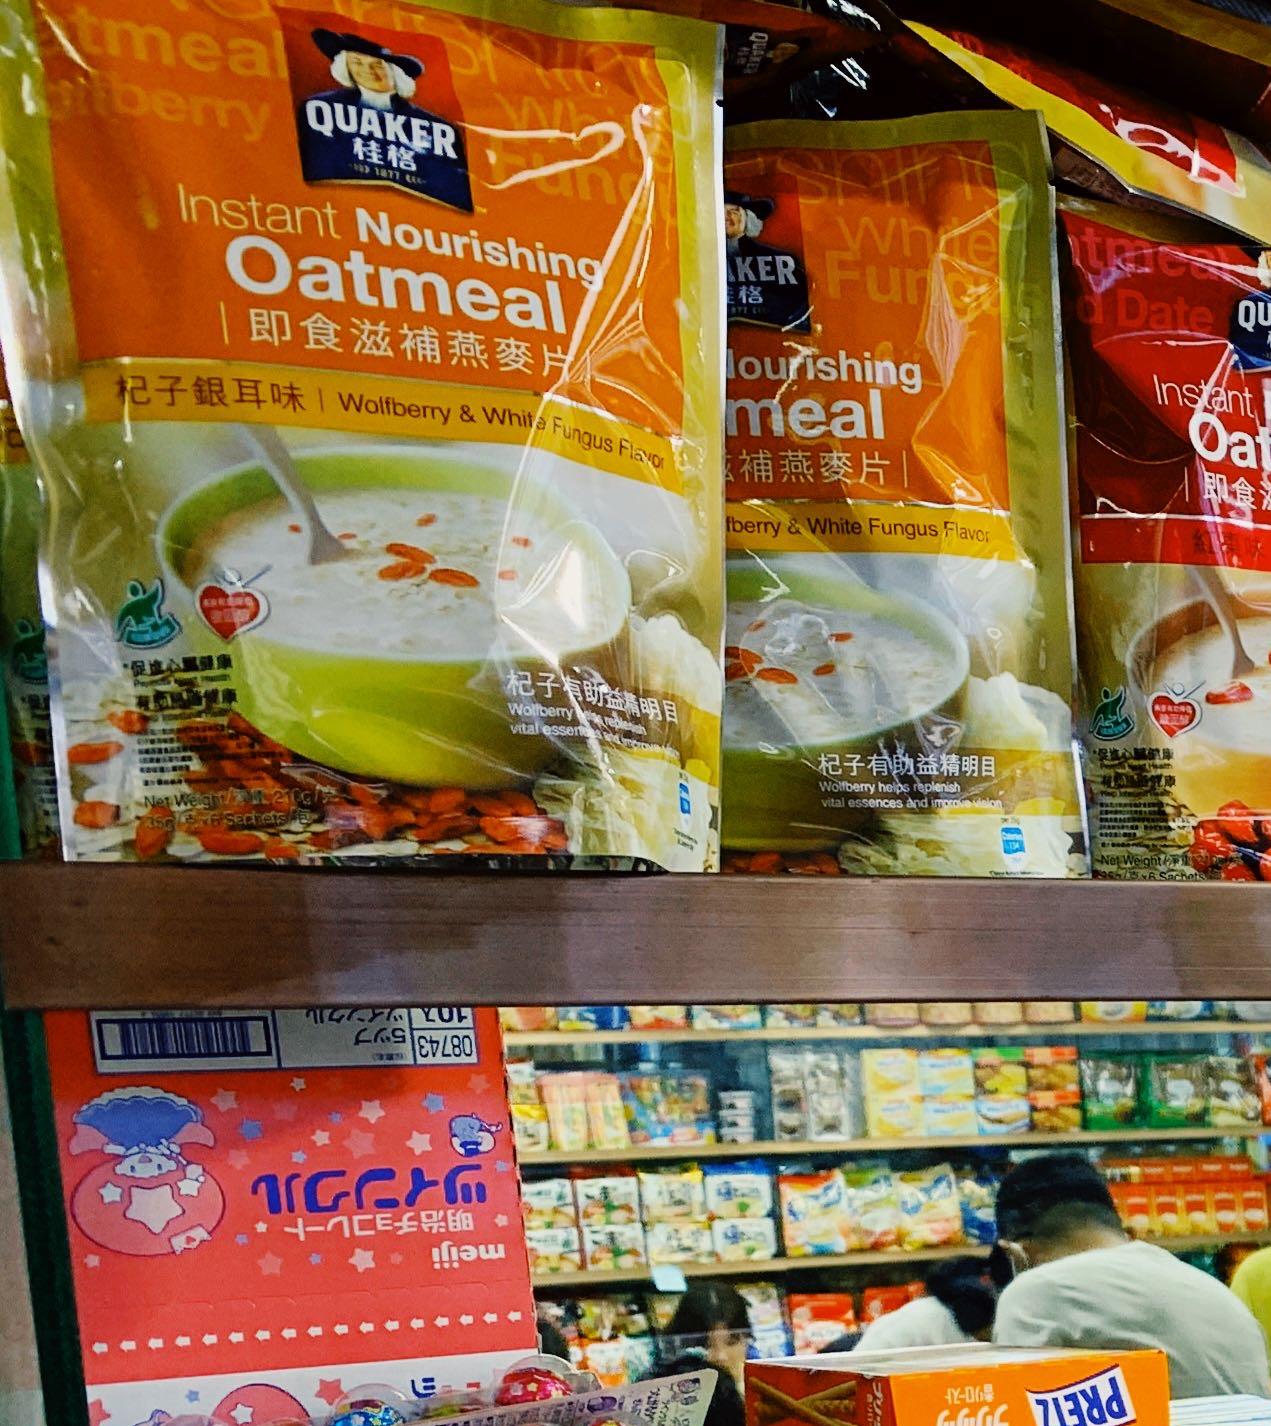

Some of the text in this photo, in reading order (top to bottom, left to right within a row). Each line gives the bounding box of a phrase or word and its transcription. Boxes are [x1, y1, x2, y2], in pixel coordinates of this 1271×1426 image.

[307, 100, 457, 160] QUAKER
[353, 136, 417, 173] 桂格
[179, 184, 602, 292] Instant Nourishing
[225, 235, 567, 335] Oatmeal
[114, 373, 305, 412] 杞子銀耳味
[1152, 374, 1255, 418] Instant
[338, 391, 665, 472] Wolfberry & White Fungus Flavor
[804, 515, 990, 544] White Fungus Flavor
[819, 753, 995, 778] 杞子有助益精明目
[819, 779, 875, 796] Wolfberry
[417, 1032, 473, 1058] 08743
[252, 1165, 487, 1214] ツインクル
[283, 1210, 473, 1241] 明治チョコレート
[432, 1243, 505, 1271] meiji
